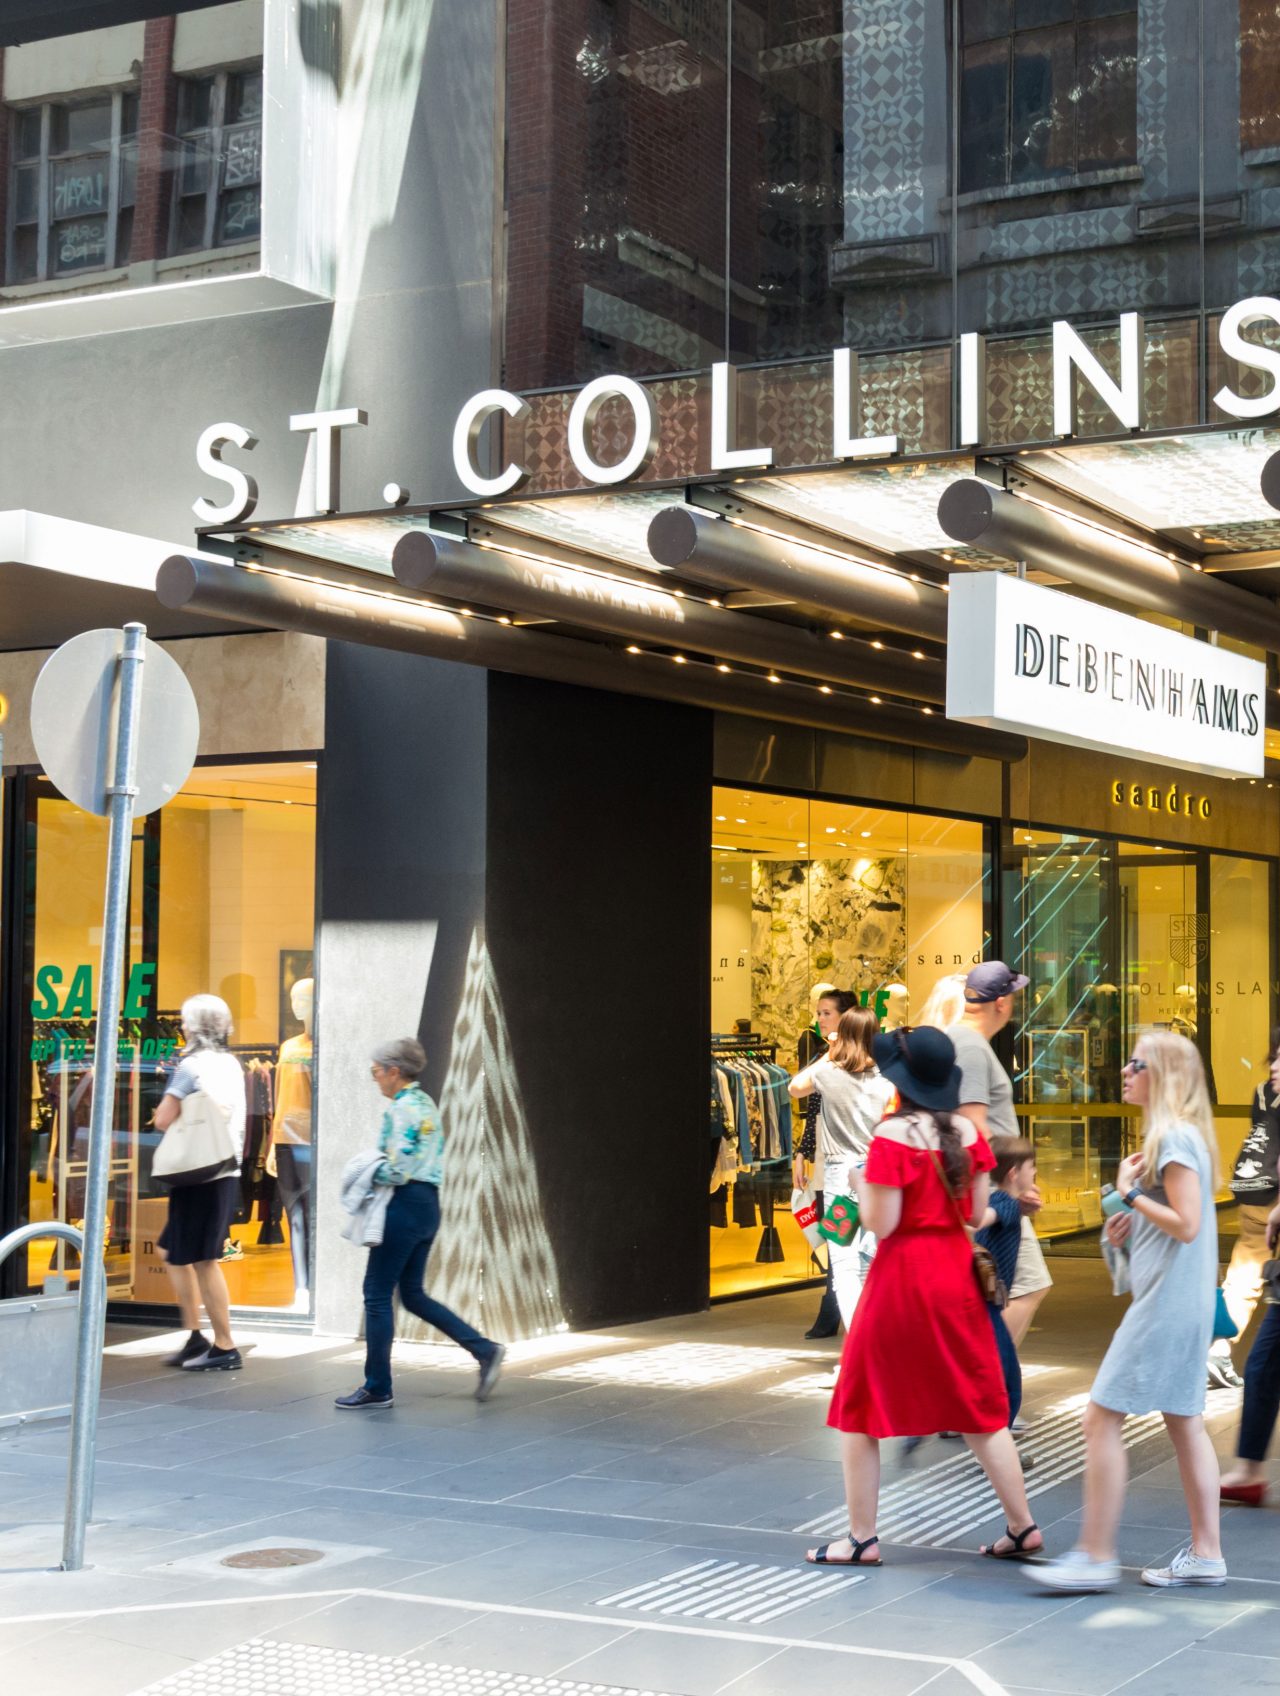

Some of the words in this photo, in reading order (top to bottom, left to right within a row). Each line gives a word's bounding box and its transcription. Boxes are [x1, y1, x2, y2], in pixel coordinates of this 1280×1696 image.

[193, 407, 410, 525] ST.
[1014, 623, 1259, 737] DEBENHAMS
[1112, 781, 1212, 818] sandro
[917, 951, 981, 965] sand
[31, 963, 156, 1020] SAE
[31, 1040, 56, 1061] UP
[63, 1040, 87, 1060] TO
[142, 1039, 177, 1060] OFF
